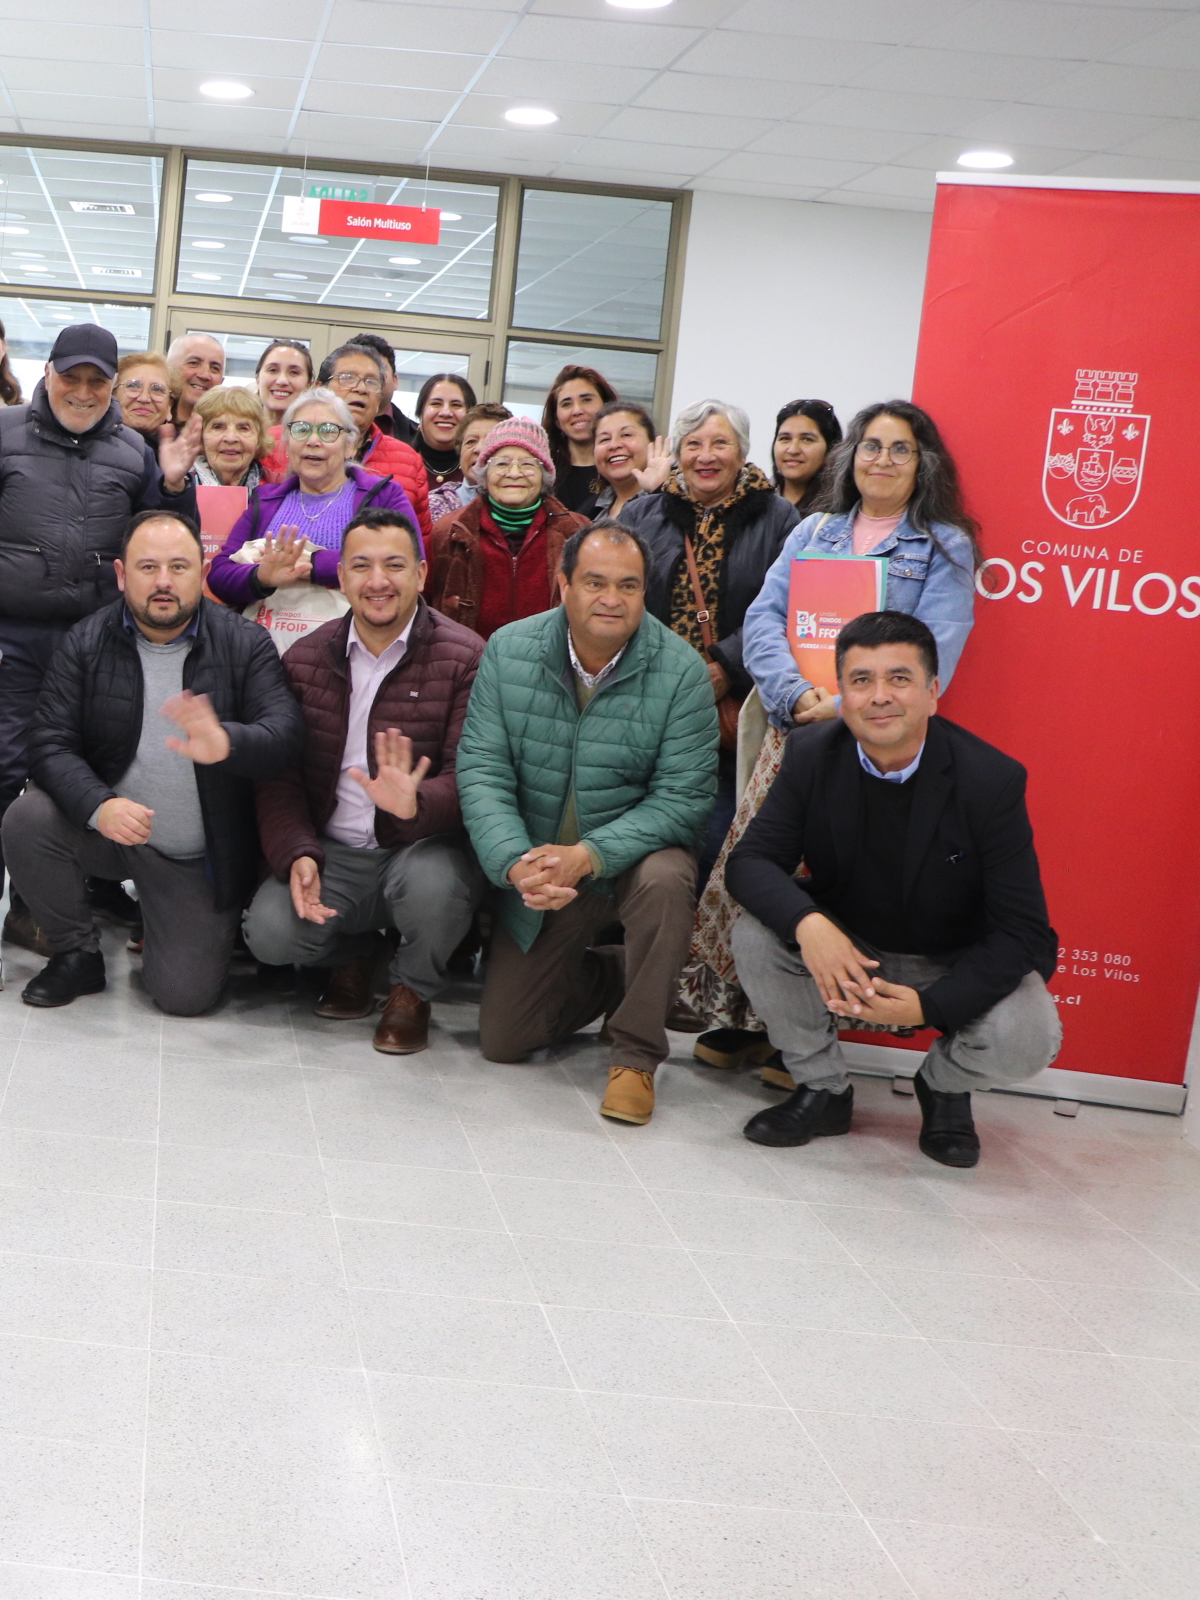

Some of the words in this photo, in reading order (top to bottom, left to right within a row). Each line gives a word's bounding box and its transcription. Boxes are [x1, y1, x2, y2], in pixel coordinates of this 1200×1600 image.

[346, 215, 372, 227] Salón
[373, 218, 412, 231] Multiuso
[1021, 539, 1110, 561] COMUNA
[1118, 548, 1144, 564] DE
[974, 557, 1046, 604] OS
[1060, 564, 1200, 619] VILOS
[274, 621, 308, 633] FFOIP
[1071, 949, 1099, 962] 353
[1103, 953, 1132, 966] 080
[1057, 964, 1067, 974] e
[1072, 964, 1097, 977] Los
[1103, 968, 1141, 983] Vilos
[1053, 994, 1081, 1006] s.cl
